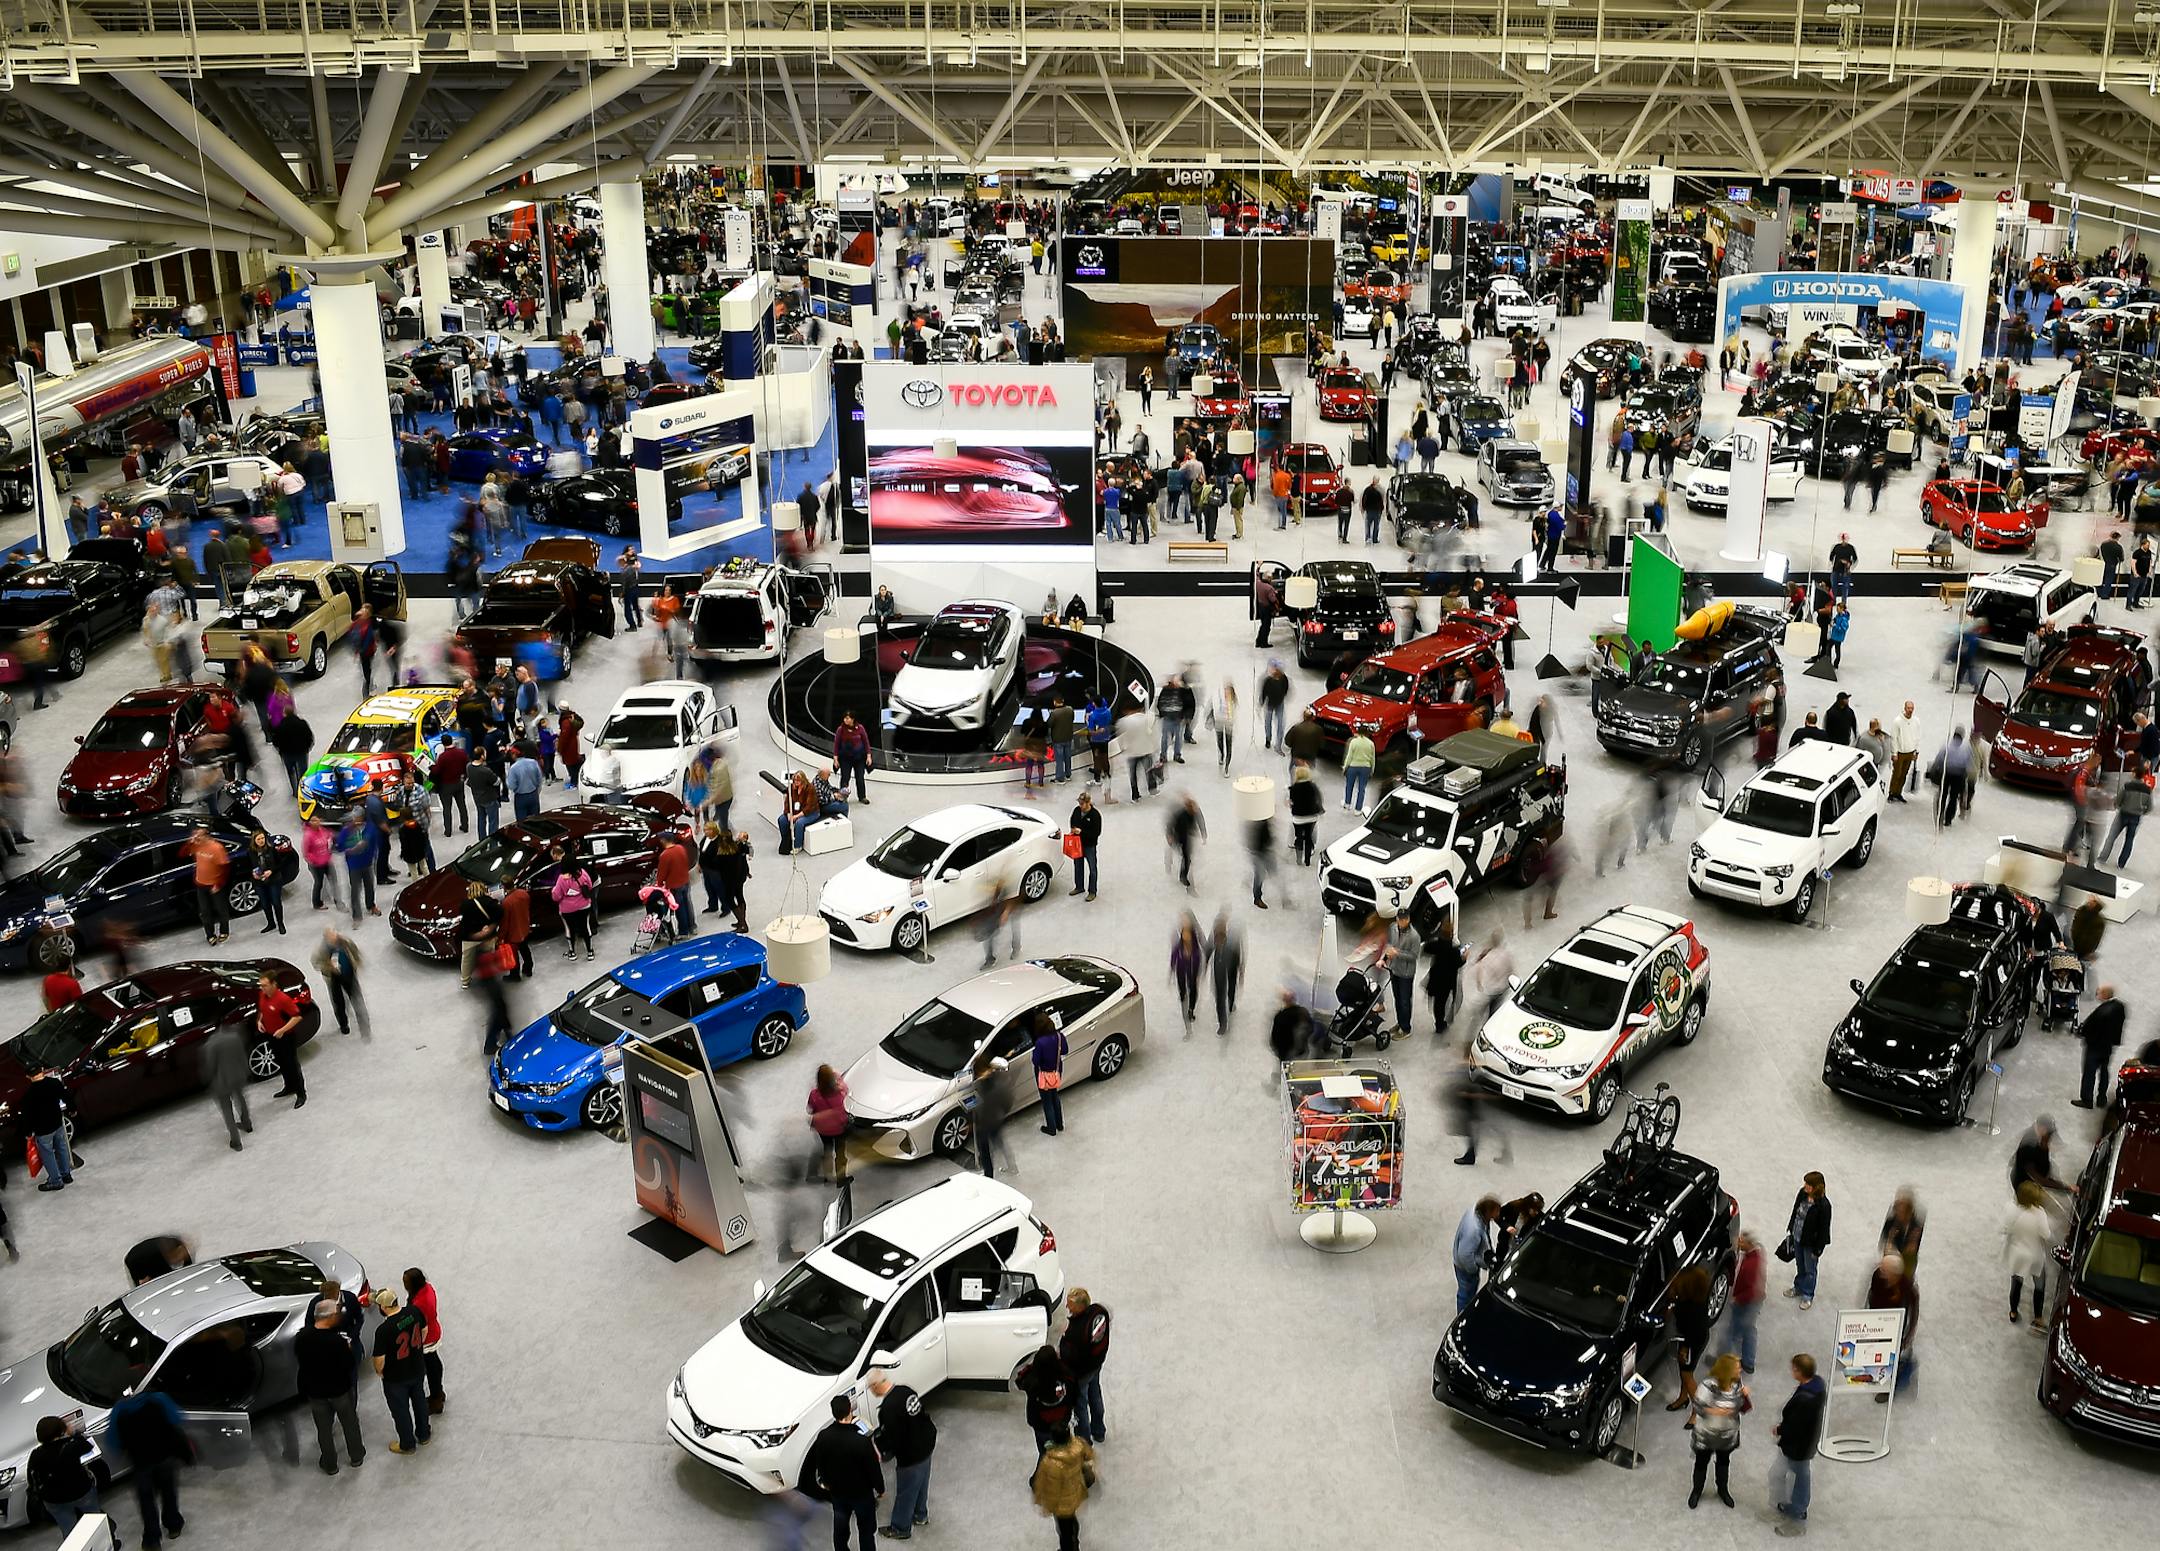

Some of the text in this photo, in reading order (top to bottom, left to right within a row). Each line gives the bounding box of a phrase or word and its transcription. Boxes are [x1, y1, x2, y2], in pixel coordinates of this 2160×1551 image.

[1166, 168, 1216, 188] Jeep
[1381, 172, 1406, 184] Jeep
[1792, 282, 1884, 299] HONDA
[1231, 313, 1320, 321] DRIVING MATTERS
[1803, 310, 1829, 322] WIN
[159, 358, 203, 384] SUPER FUELS
[948, 384, 1057, 406] TOYOTA
[675, 411, 706, 428] SUBARU
[1512, 1048, 1548, 1065] TOYOTA
[637, 1073, 679, 1099] NAVIGATION
[1316, 1140, 1382, 1153] RAV4
[1316, 1153, 1380, 1175] 73.4
[1316, 1176, 1380, 1187] CUBIC FEET
[397, 1323, 421, 1360] 24
